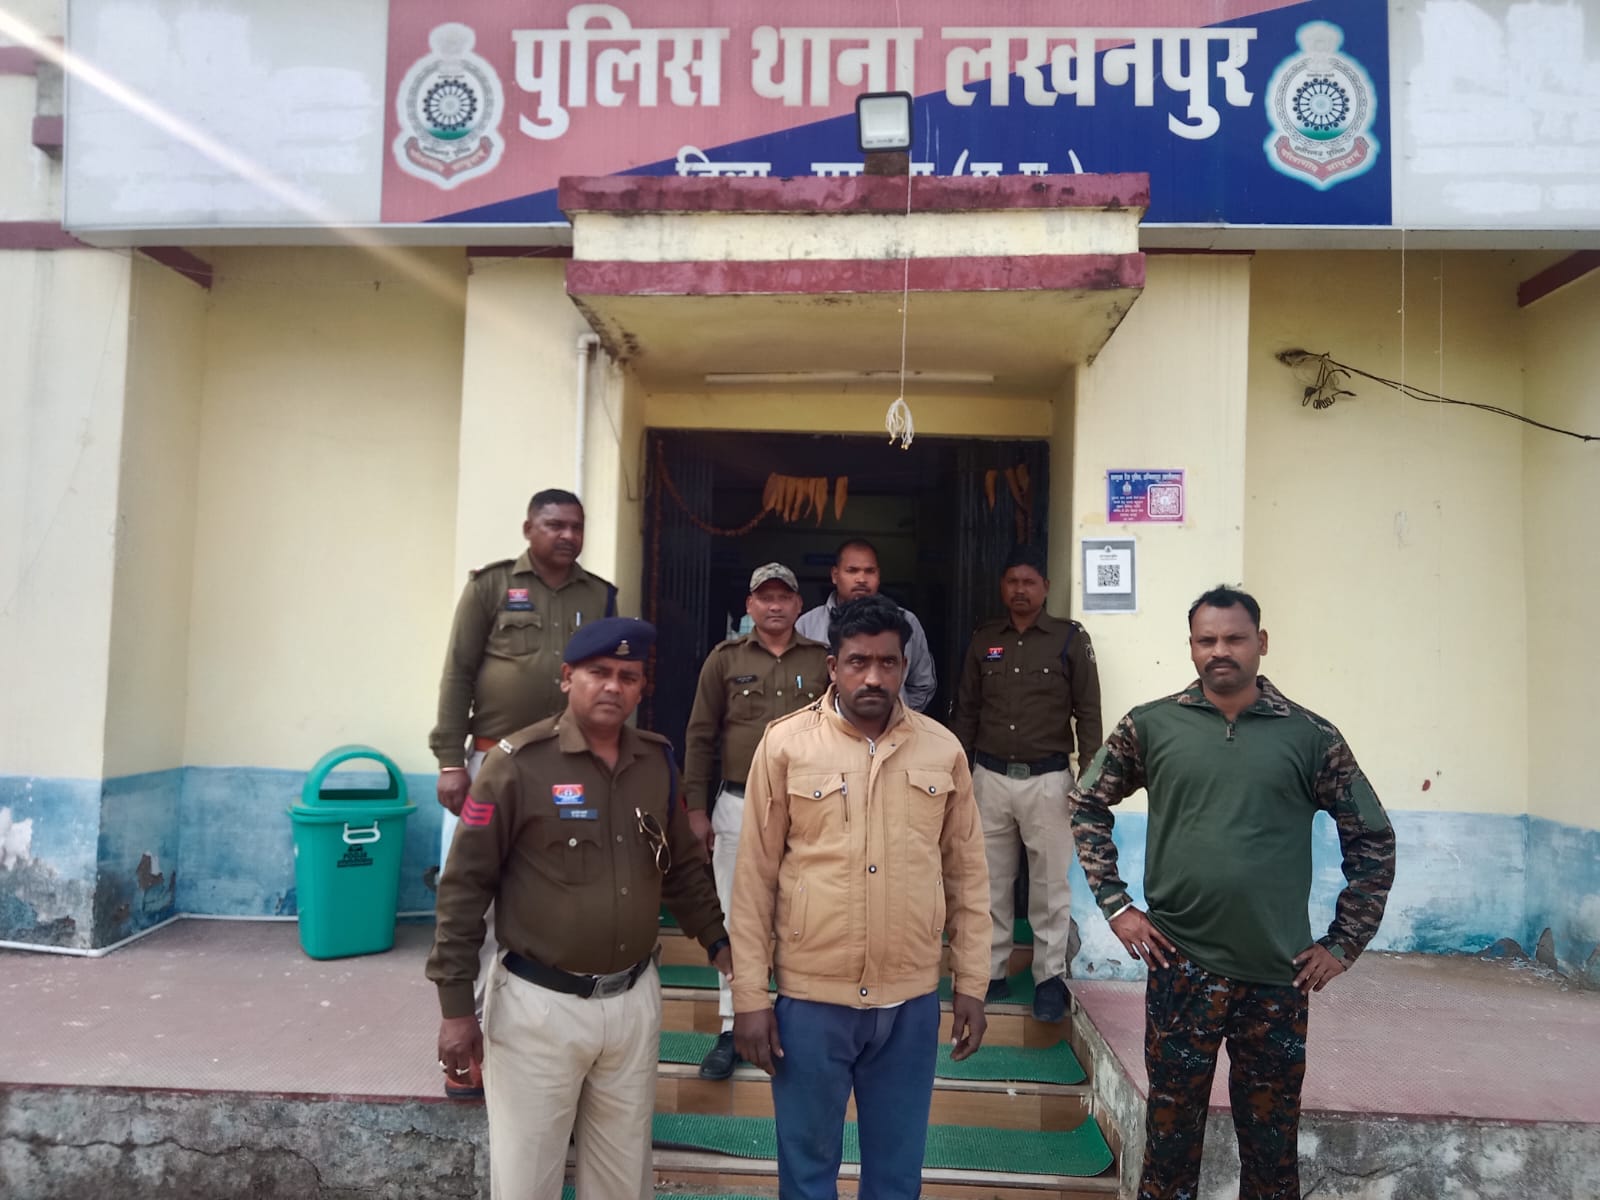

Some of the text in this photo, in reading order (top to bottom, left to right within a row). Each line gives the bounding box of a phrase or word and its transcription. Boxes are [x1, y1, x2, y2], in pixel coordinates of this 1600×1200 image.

[511, 4, 1258, 140] पुलिस थाना लखनपुर
